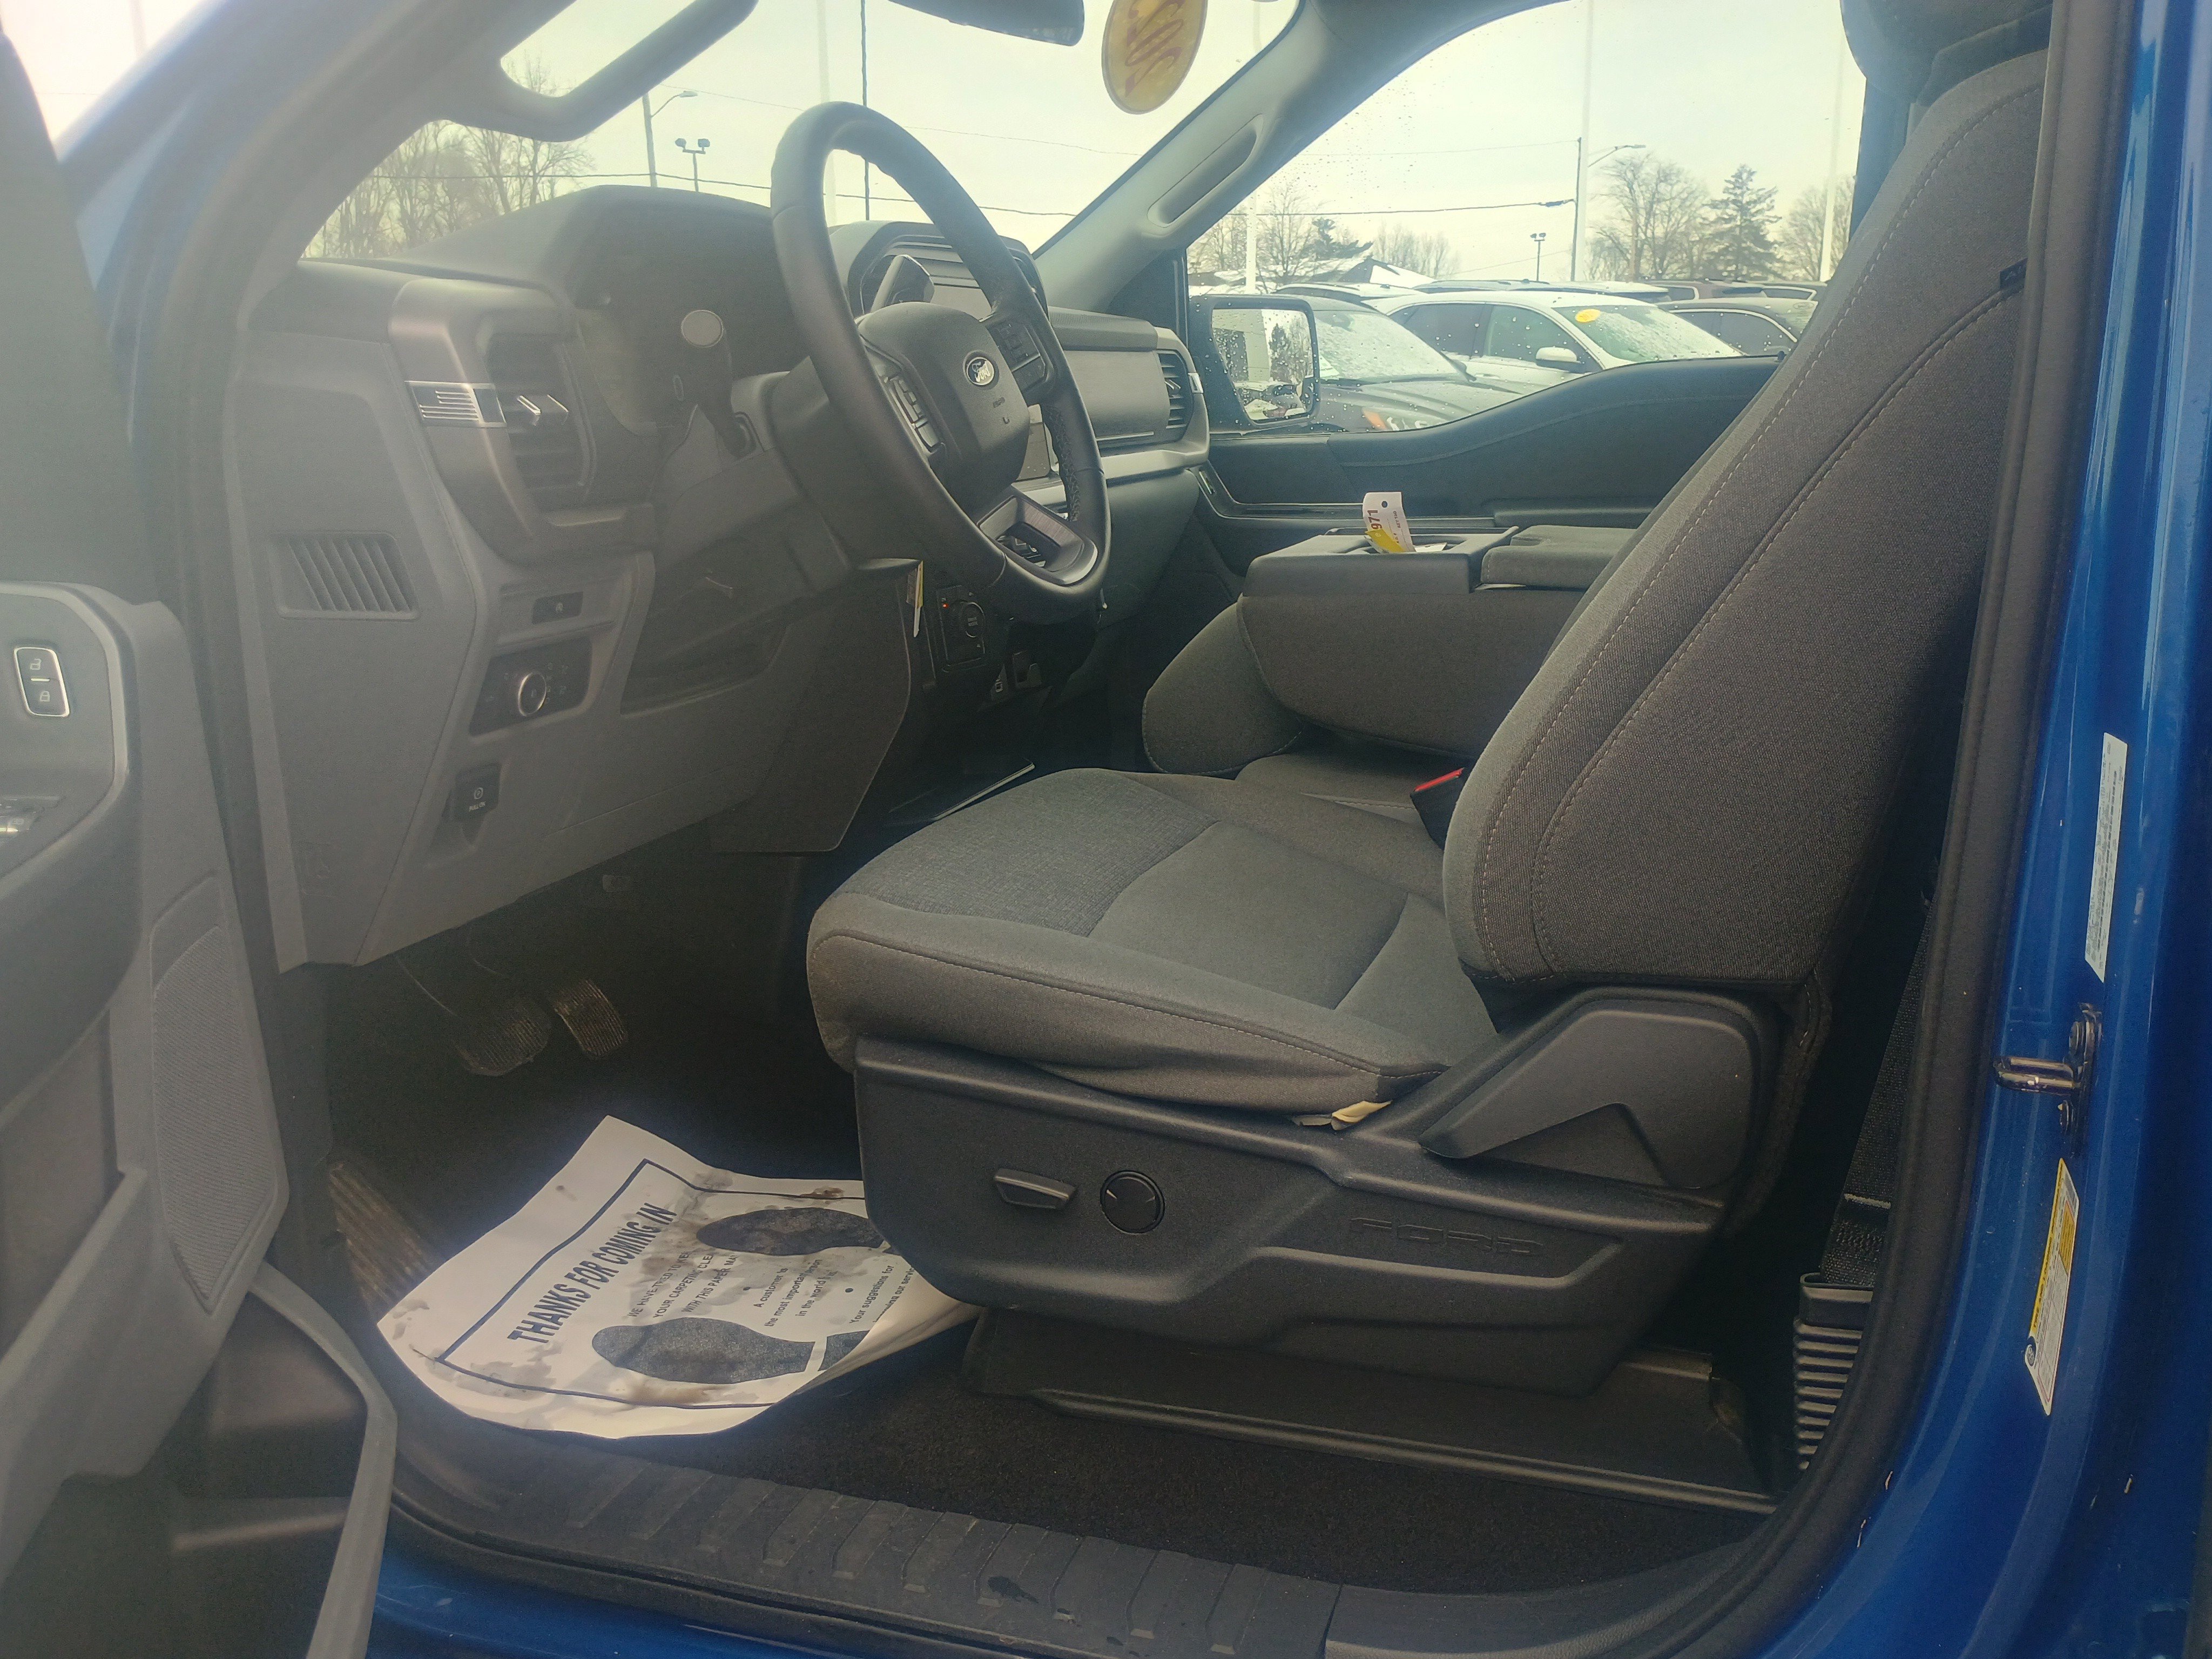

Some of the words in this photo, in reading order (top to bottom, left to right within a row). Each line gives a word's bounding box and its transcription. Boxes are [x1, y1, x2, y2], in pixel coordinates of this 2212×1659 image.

[972, 361, 991, 382] Ford
[1367, 510, 1382, 530] 971
[1350, 1217, 1543, 1256] FORD
[507, 1283, 591, 1344] THANKS
[564, 1260, 619, 1290] FOR
[592, 1221, 662, 1265] COMING
[636, 1203, 677, 1225] IN
[682, 1299, 700, 1312] WITH
[696, 1287, 714, 1299] THIS
[760, 1275, 783, 1301] customer
[801, 1299, 814, 1309] the
[810, 1280, 826, 1298] world
[849, 1310, 866, 1324] Your
[862, 1275, 889, 1308] suggestions
[881, 1265, 894, 1273] for
[894, 1285, 906, 1294] our
[627, 1308, 644, 1317] WE
[637, 1288, 658, 1305] HAVE
[653, 1299, 675, 1318] YOUR
[764, 1318, 778, 1327] the
[774, 1301, 790, 1316] most
